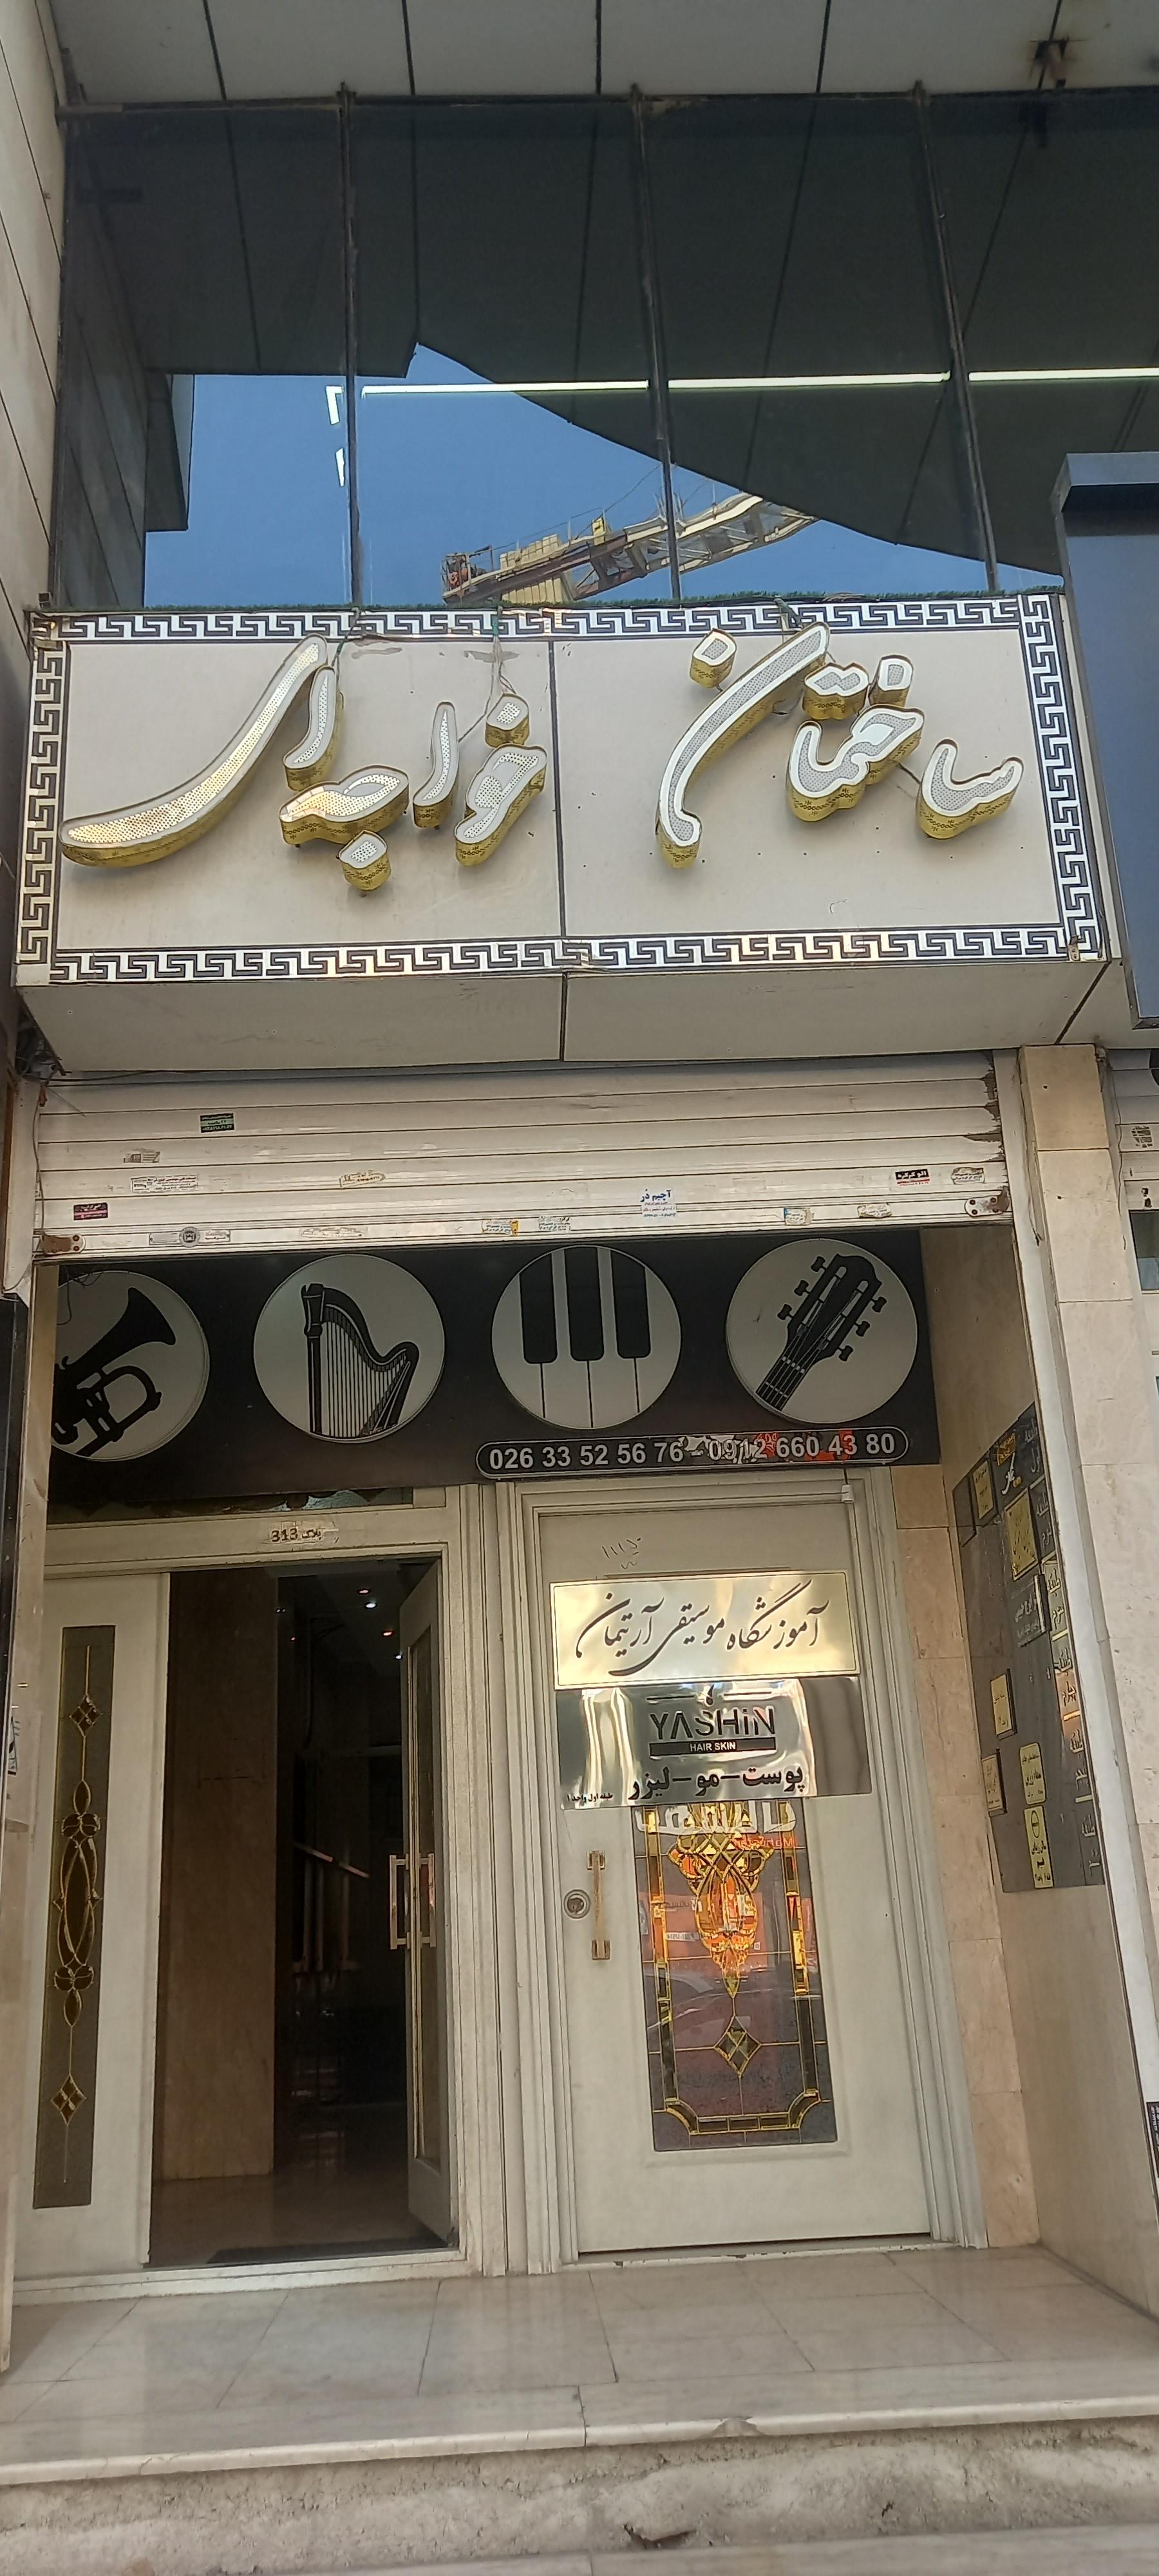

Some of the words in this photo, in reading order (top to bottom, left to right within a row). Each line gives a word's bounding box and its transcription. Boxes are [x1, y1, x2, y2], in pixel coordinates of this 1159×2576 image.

[655, 621, 1024, 868] ساختمان
[489, 1446, 534, 1470] 026
[542, 1444, 572, 1468] 33
[580, 1443, 608, 1466] 52
[617, 1442, 646, 1465] 56
[654, 1441, 683, 1463] 76
[708, 1437, 767, 1461] 0912
[776, 1435, 820, 1458] 660
[828, 1434, 858, 1456] 43
[865, 1432, 896, 1454] 80
[271, 1528, 298, 1542] 313
[1047, 1567, 1061, 1597] طبقه
[576, 1592, 665, 1658] آرتیمان
[726, 1578, 830, 1650] آموزشگاه
[1052, 1604, 1065, 1630] سوم
[608, 1602, 726, 1676] موسیقی
[1059, 1647, 1073, 1676] طبقه
[690, 1741, 713, 1753] HAIR
[714, 1739, 737, 1752] SKIN
[1069, 1728, 1085, 1758] طبقه
[572, 1794, 587, 1803] واحد
[588, 1792, 599, 1803] اول
[599, 1792, 614, 1801] طبقه
[1081, 1813, 1096, 1838] طبقه
